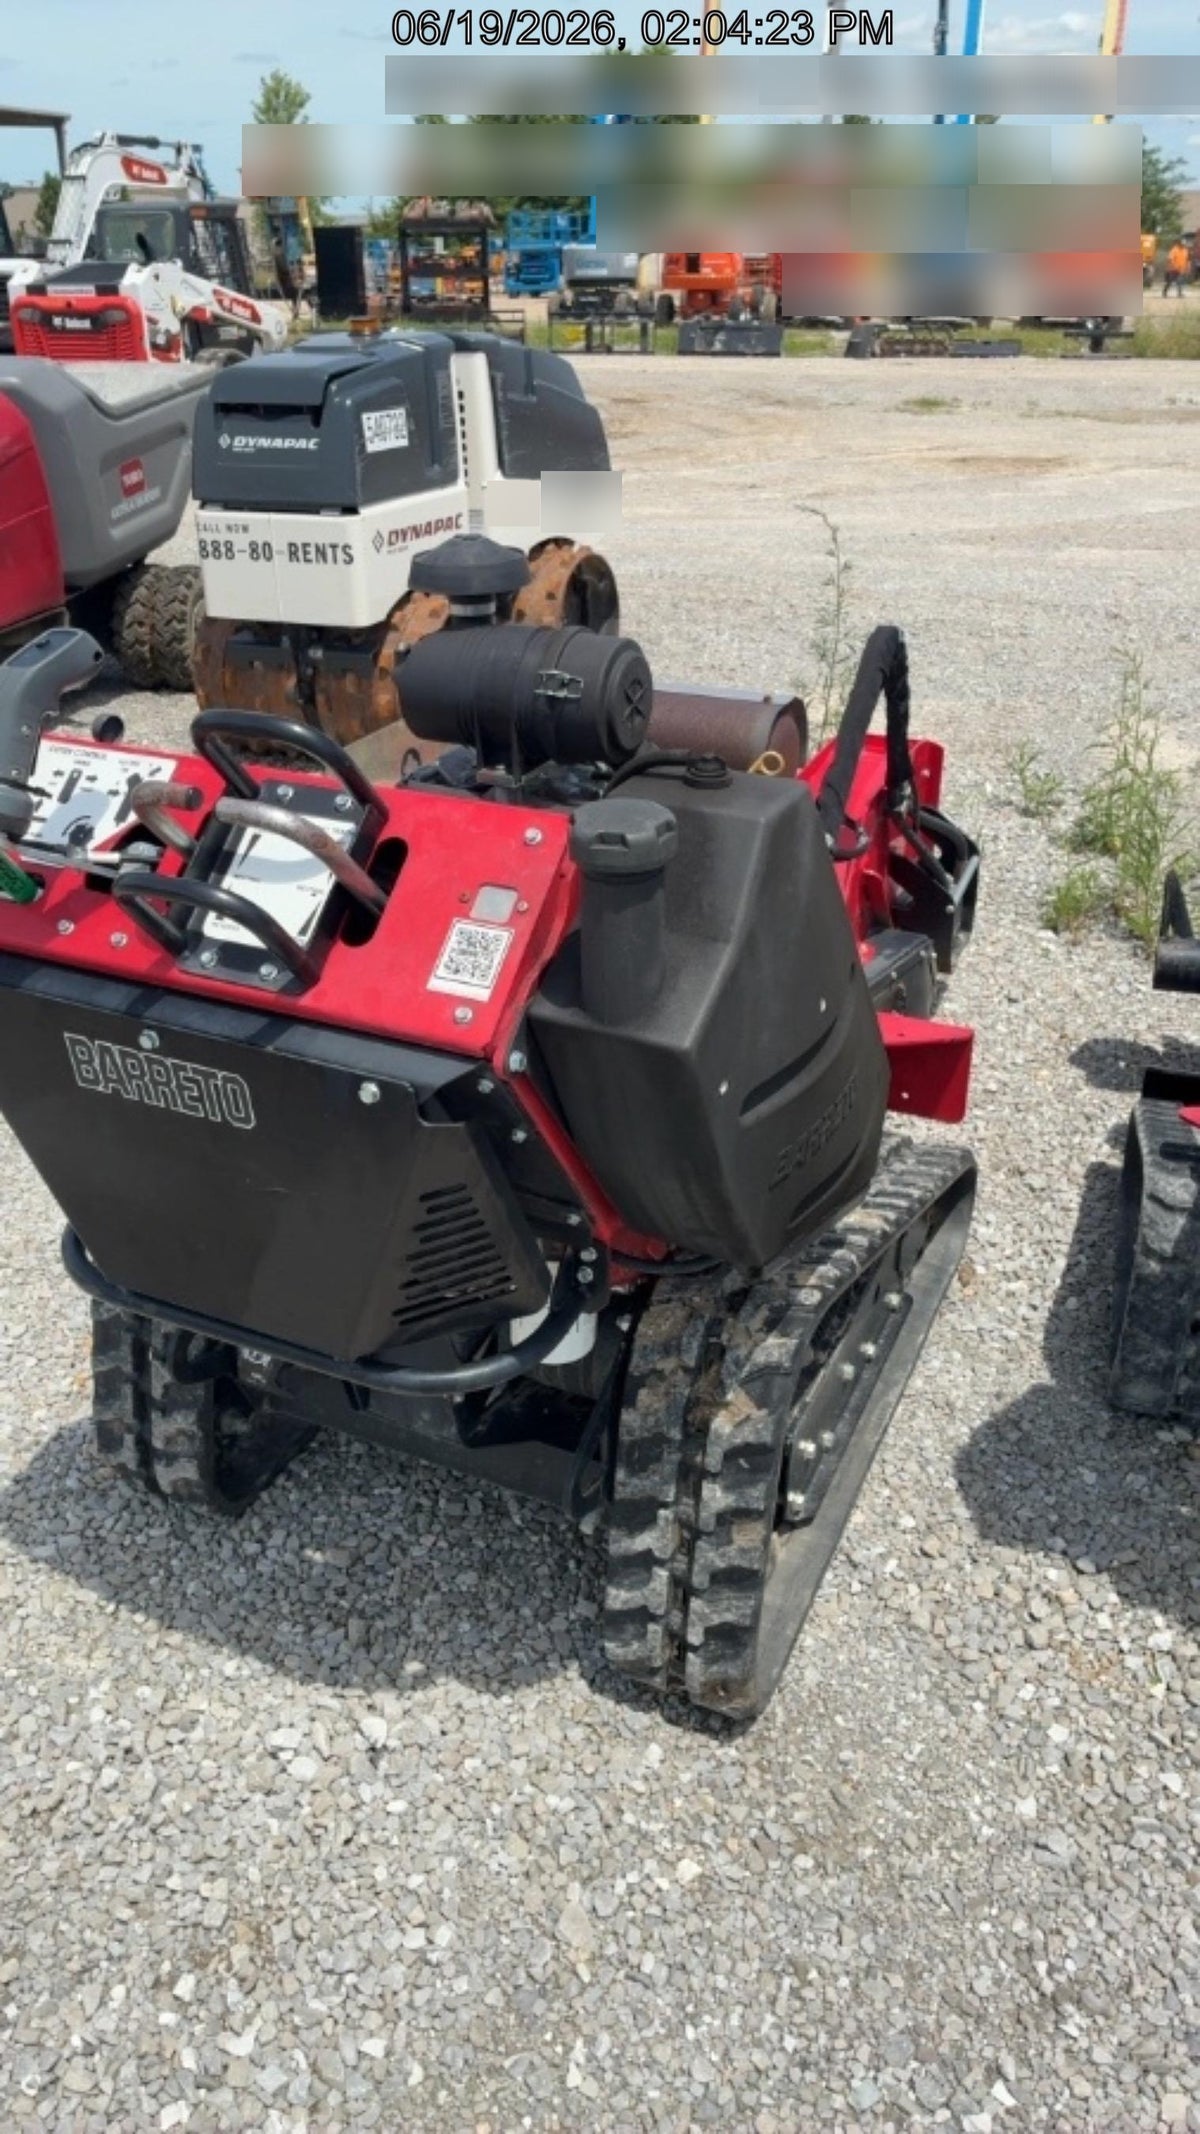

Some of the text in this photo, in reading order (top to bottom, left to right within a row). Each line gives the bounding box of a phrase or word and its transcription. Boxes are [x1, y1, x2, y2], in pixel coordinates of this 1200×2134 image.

[232, 436, 320, 450] DYNAPAC
[387, 512, 463, 546] DYNAPAC
[63, 1031, 256, 1129] BARRETO
